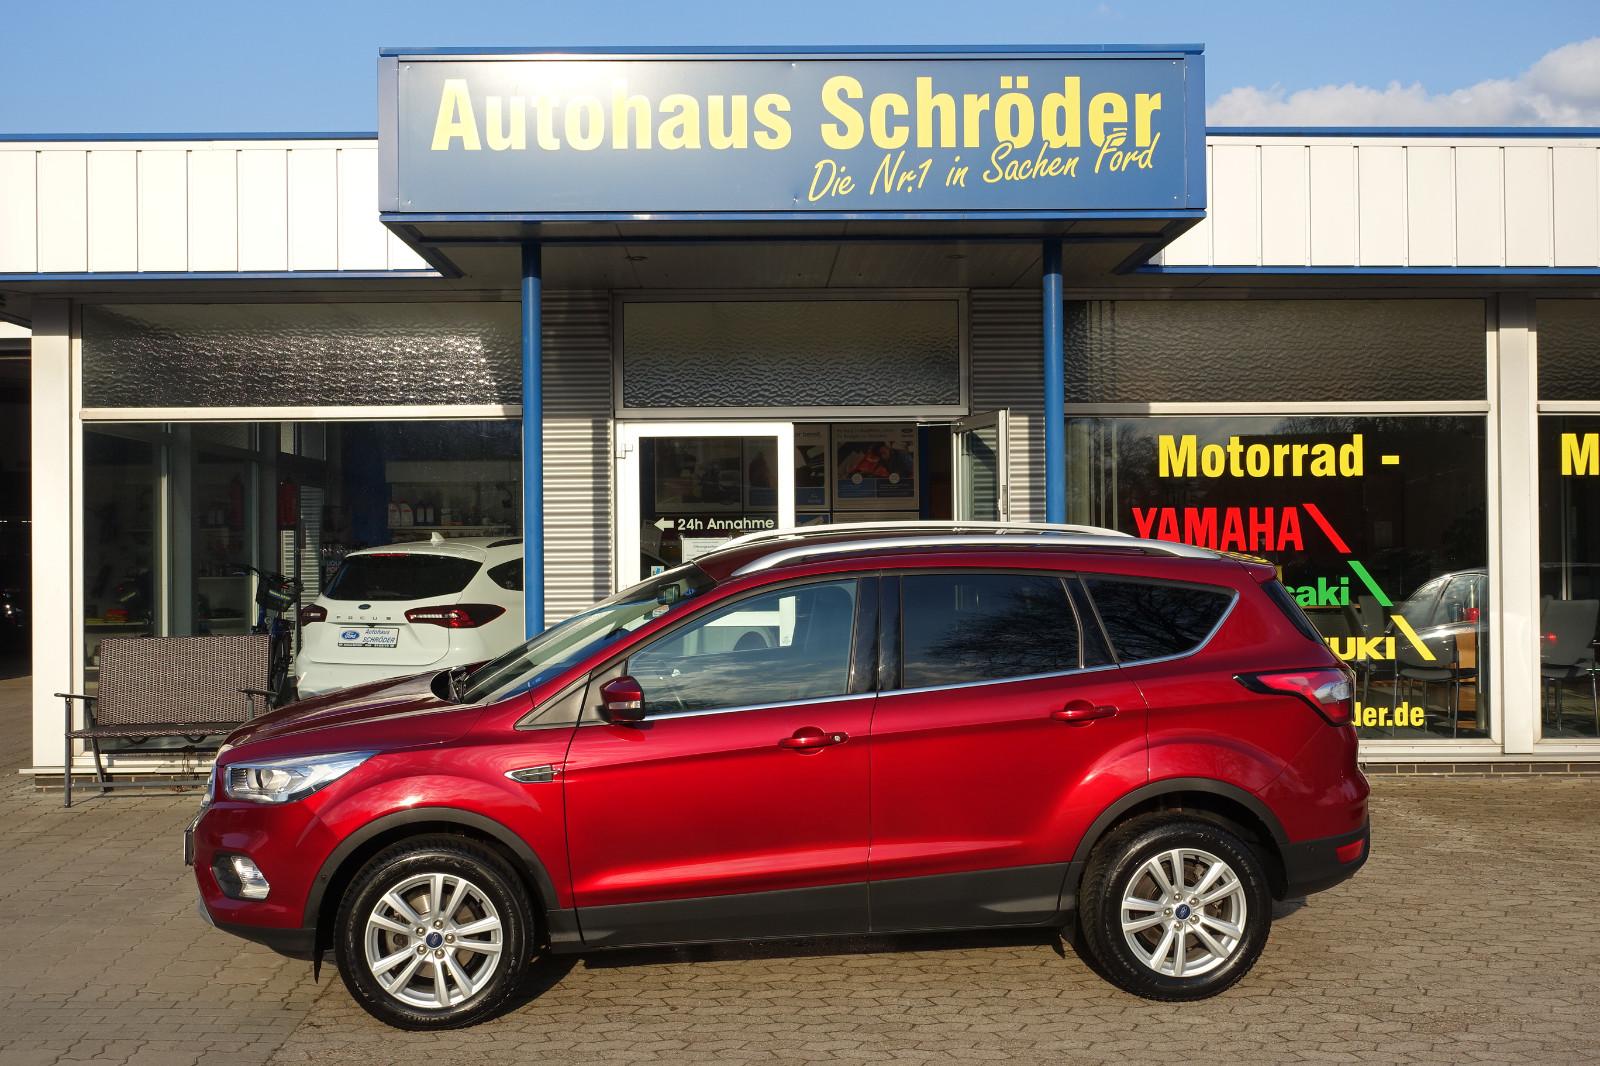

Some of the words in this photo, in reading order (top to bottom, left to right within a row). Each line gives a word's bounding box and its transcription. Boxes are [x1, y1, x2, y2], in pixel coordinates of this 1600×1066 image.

[430, 78, 792, 151] Autohaus
[821, 75, 1162, 150] Schröder
[808, 159, 855, 202] Die
[870, 150, 933, 195] Nr.1
[945, 155, 969, 187] in
[982, 140, 1080, 183] Sachen
[1094, 131, 1161, 174] Ford
[1157, 433, 1364, 478] Motorrad
[677, 518, 704, 531] 24h
[706, 517, 775, 530] Annahme
[1131, 506, 1304, 552] YAMAHA
[1323, 635, 1396, 661] UKI
